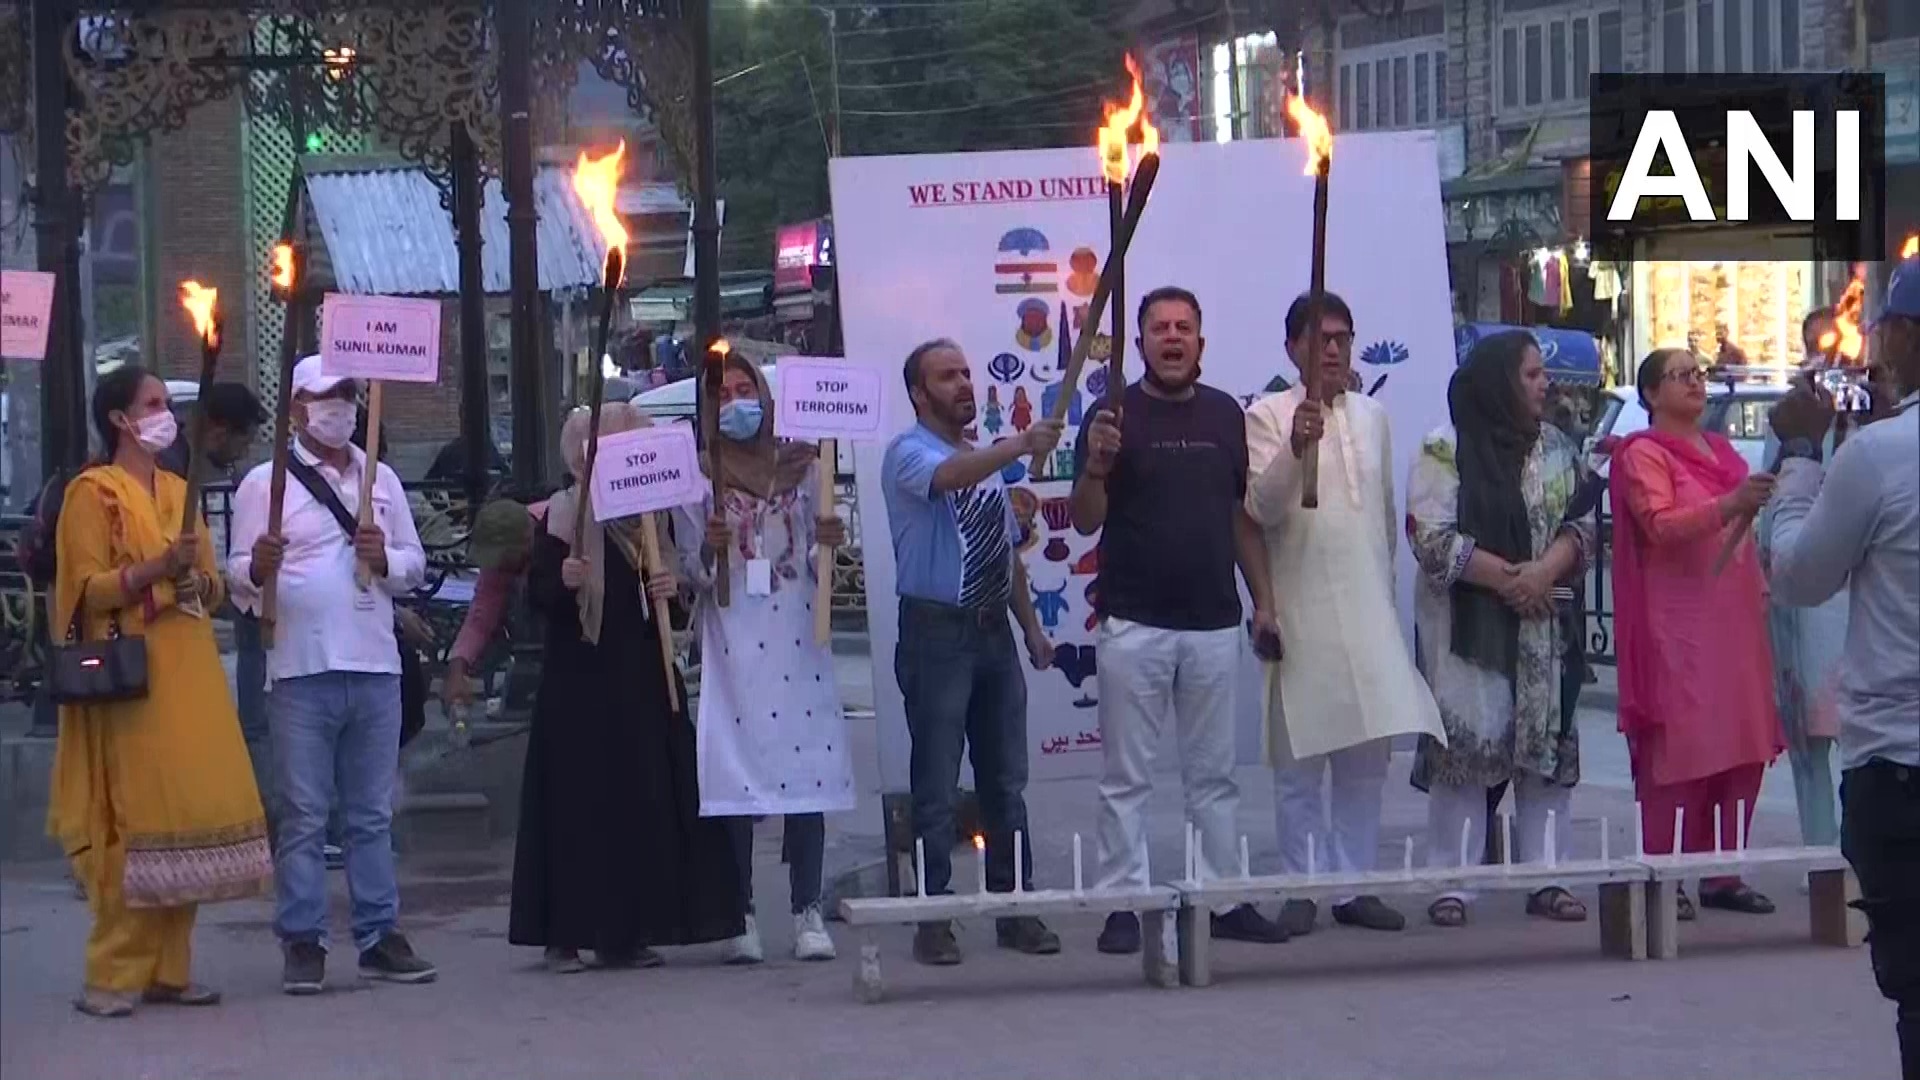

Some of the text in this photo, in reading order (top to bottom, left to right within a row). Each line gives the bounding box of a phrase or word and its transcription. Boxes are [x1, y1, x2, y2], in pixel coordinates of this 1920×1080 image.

[909, 183, 947, 204] WE
[952, 180, 1033, 201] STAND
[374, 321, 397, 333] AM
[334, 340, 426, 356] SUNIL KUMAR
[816, 380, 848, 392] STOP
[795, 401, 868, 415] TERRORISM
[625, 452, 657, 468] STOP
[609, 468, 681, 491] TERRORISM
